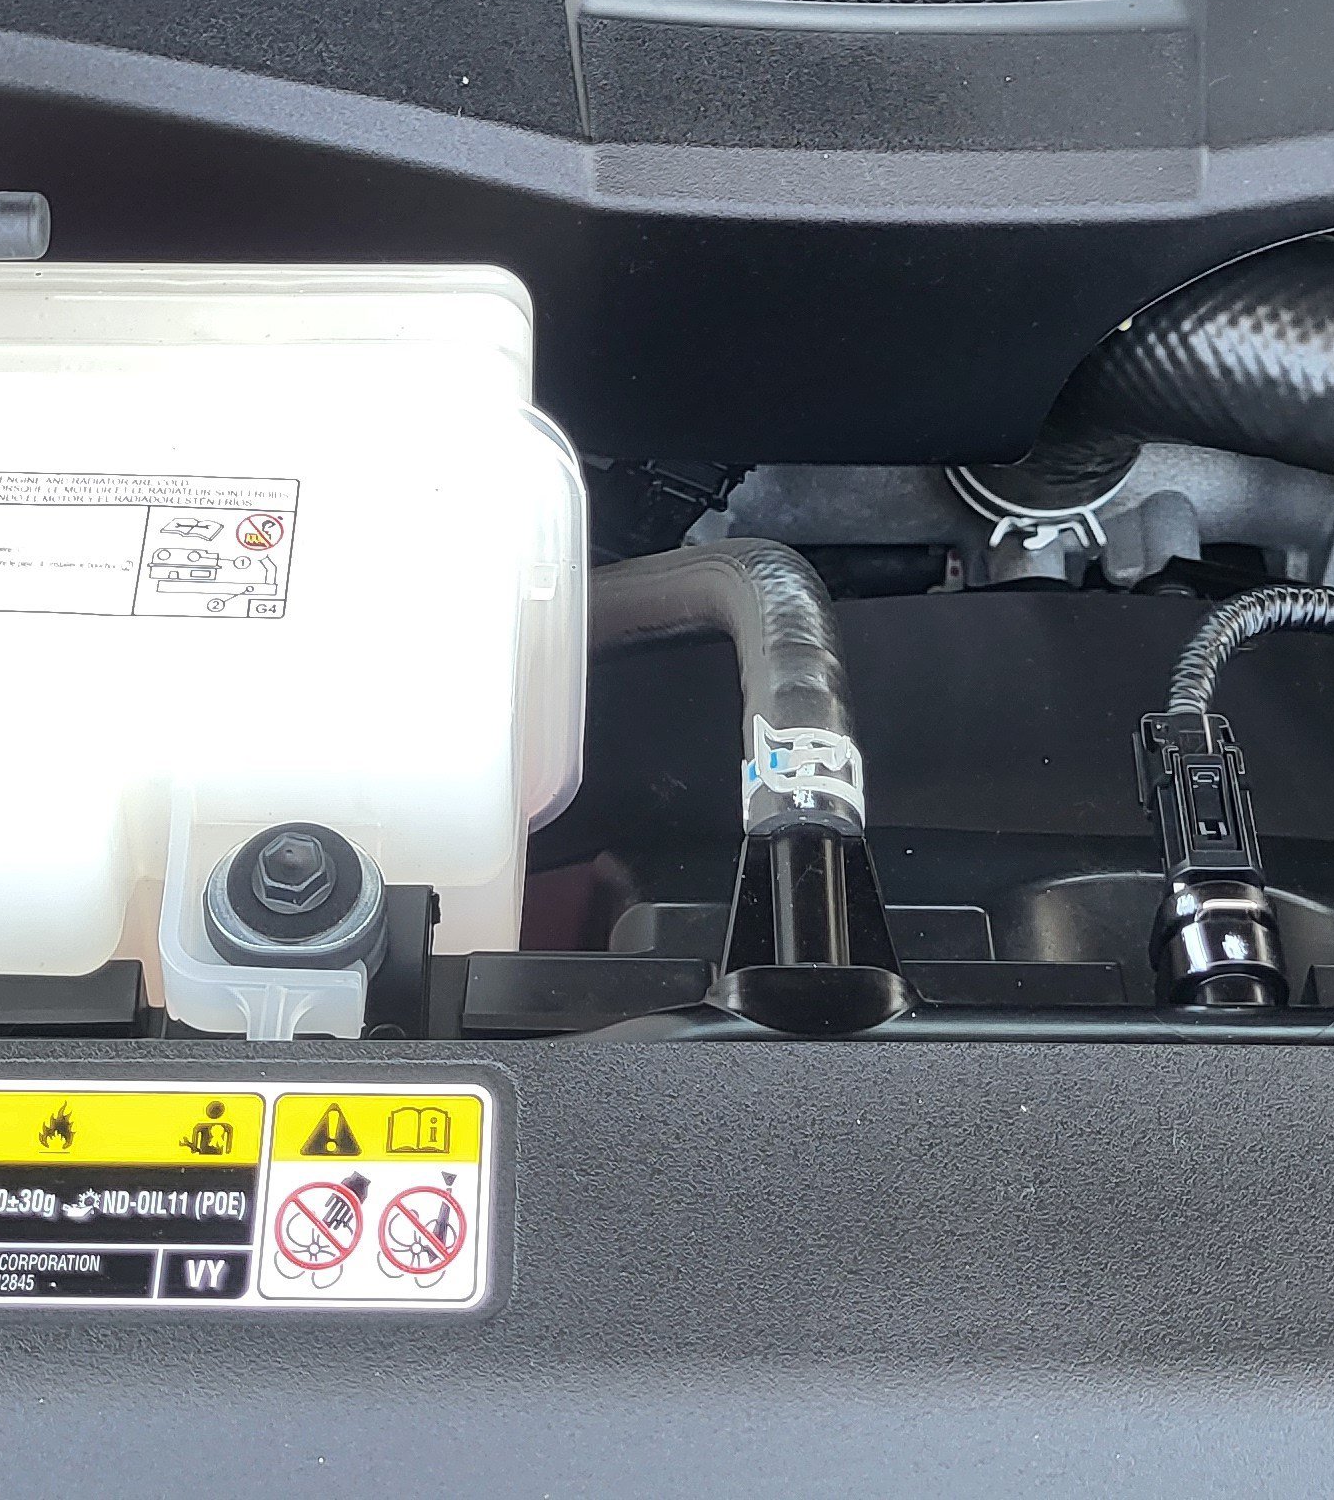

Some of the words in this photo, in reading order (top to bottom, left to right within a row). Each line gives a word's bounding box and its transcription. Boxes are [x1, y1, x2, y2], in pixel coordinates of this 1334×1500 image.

[255, 603, 277, 614] G4
[102, 1190, 188, 1215] ND-OIL11
[193, 1190, 247, 1219] (POE)
[0, 1253, 100, 1272] CORPORATION
[186, 1258, 226, 1288] VY
